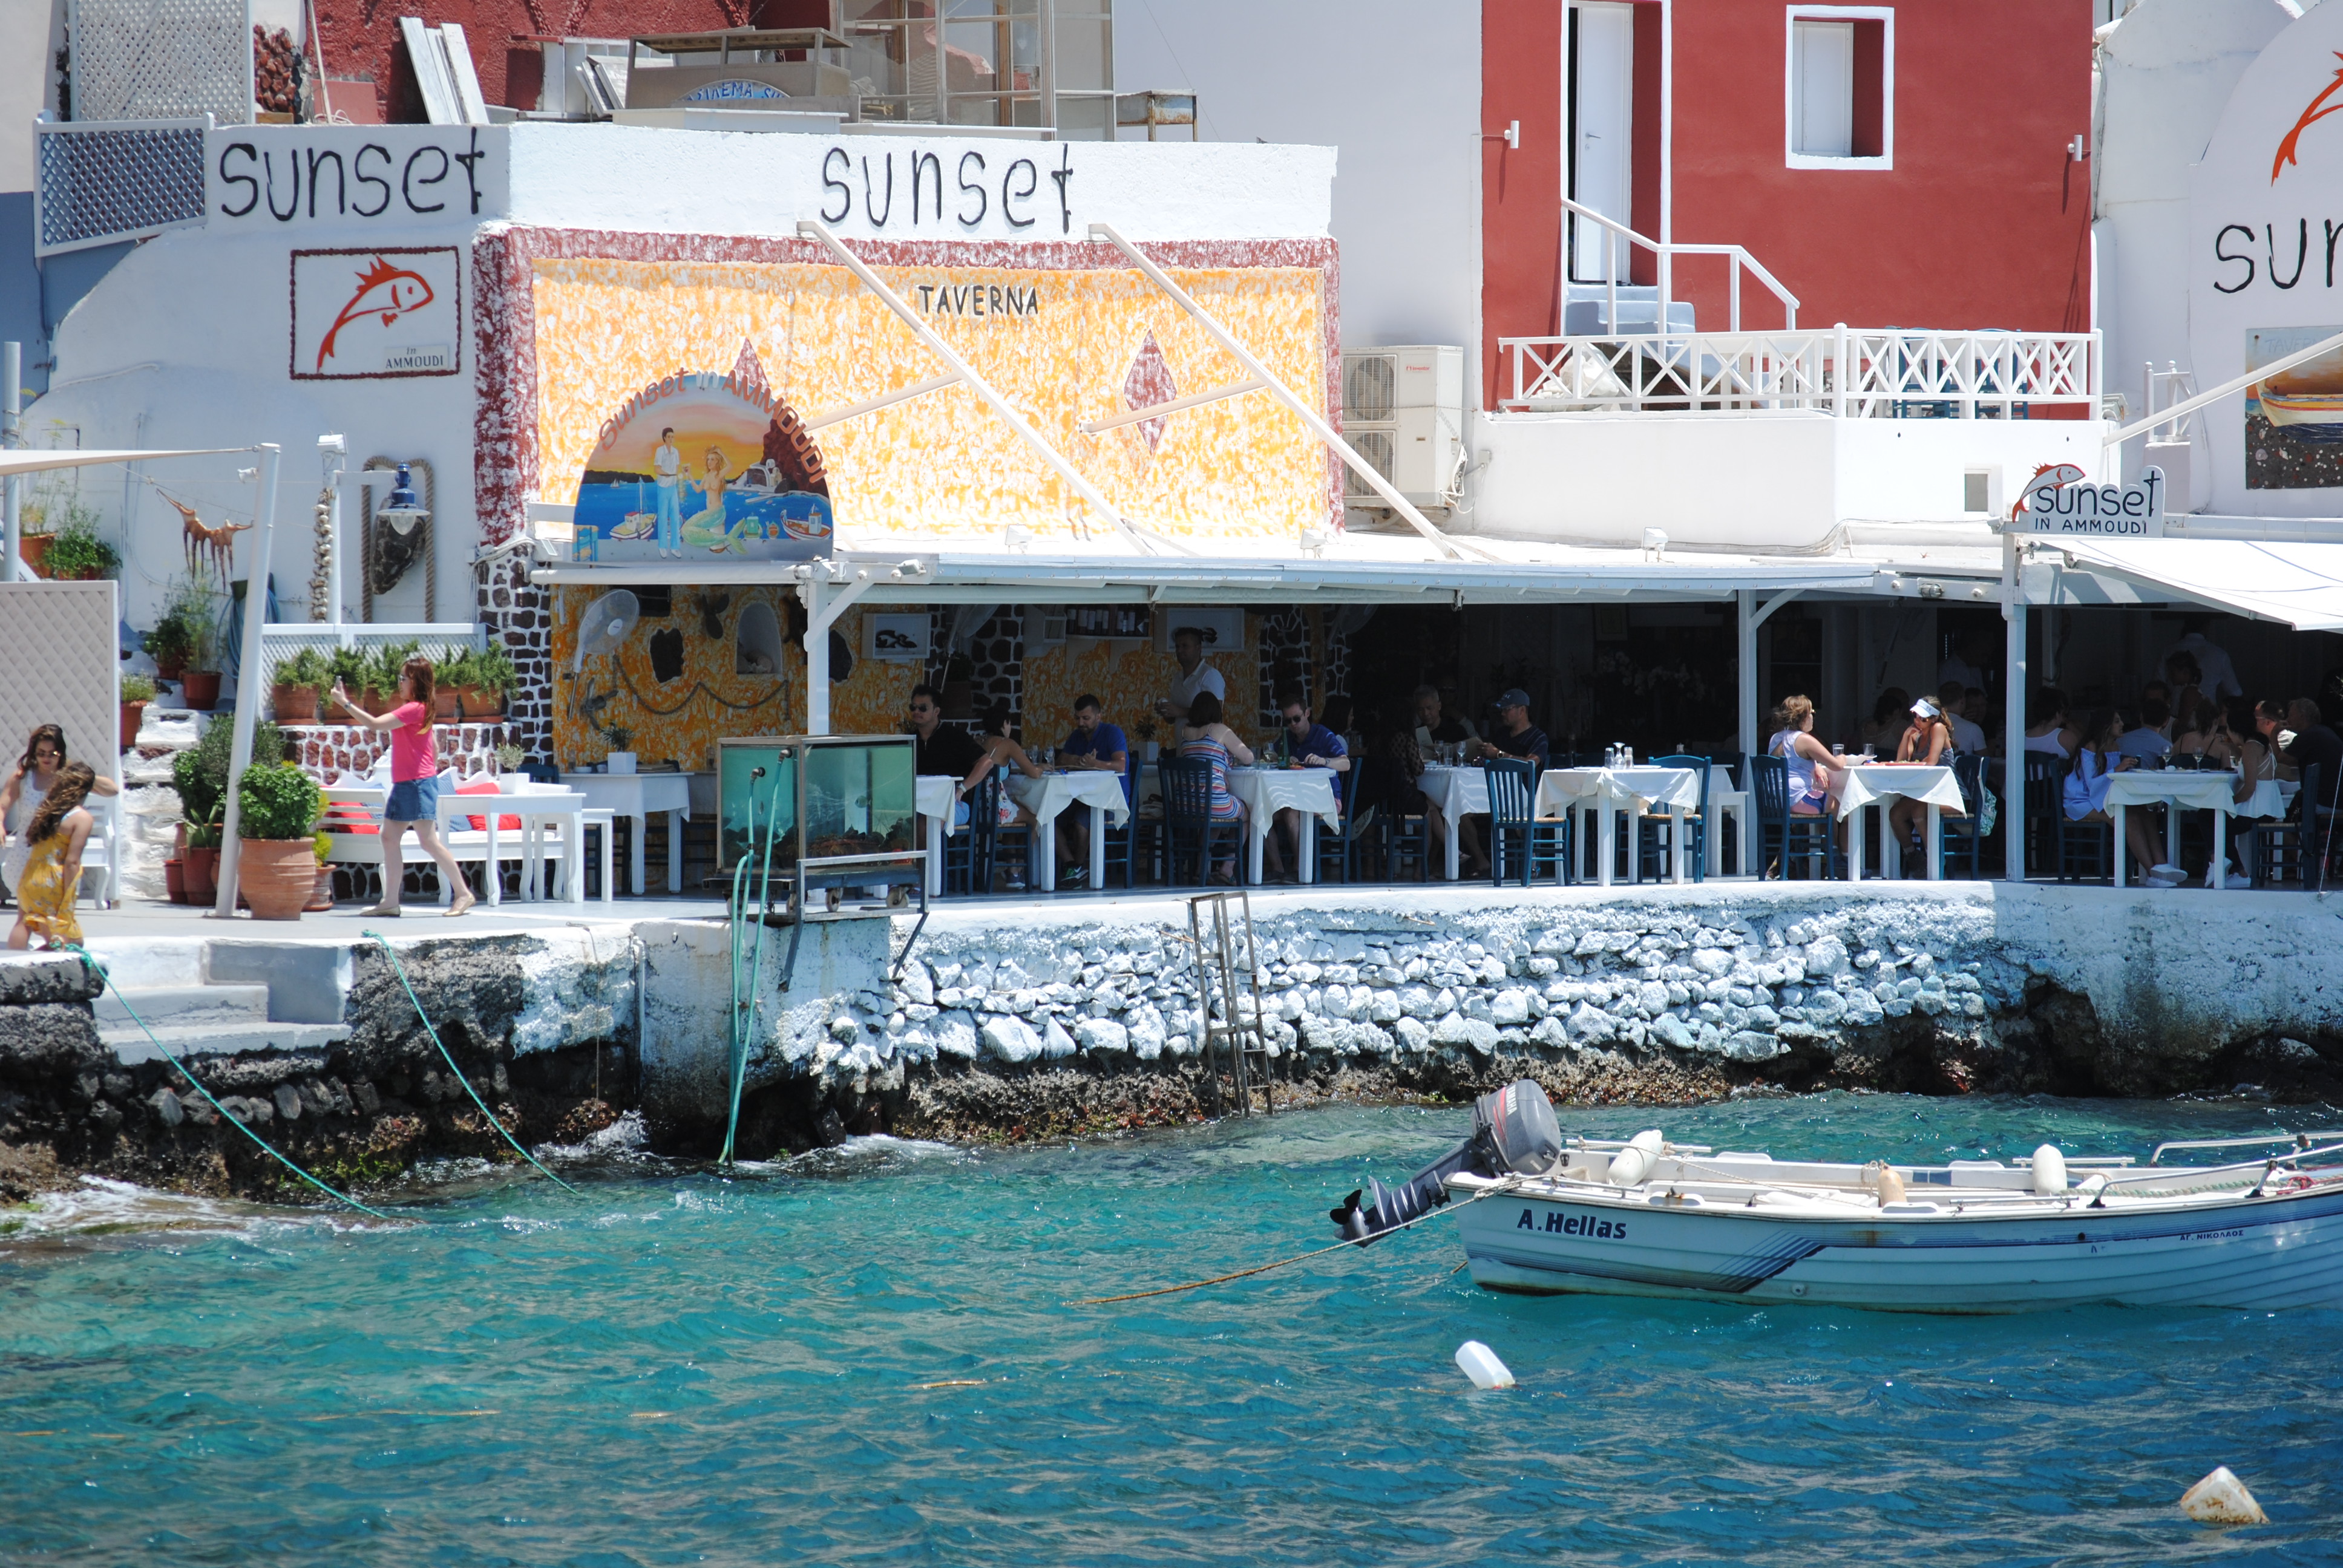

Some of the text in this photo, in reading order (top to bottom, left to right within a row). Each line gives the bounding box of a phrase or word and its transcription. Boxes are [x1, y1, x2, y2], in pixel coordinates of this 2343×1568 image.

[917, 285, 1038, 316] TAVERNA
[406, 347, 416, 355] in
[2266, 336, 2324, 353] TAVER
[385, 355, 444, 369] AMMOUDI
[599, 367, 828, 484] Sunset in AMMOUDI
[2035, 517, 2148, 535] IN AMMOUDI
[2197, 1230, 2244, 1240] ΝΙΚΟΛΑΟΣ
